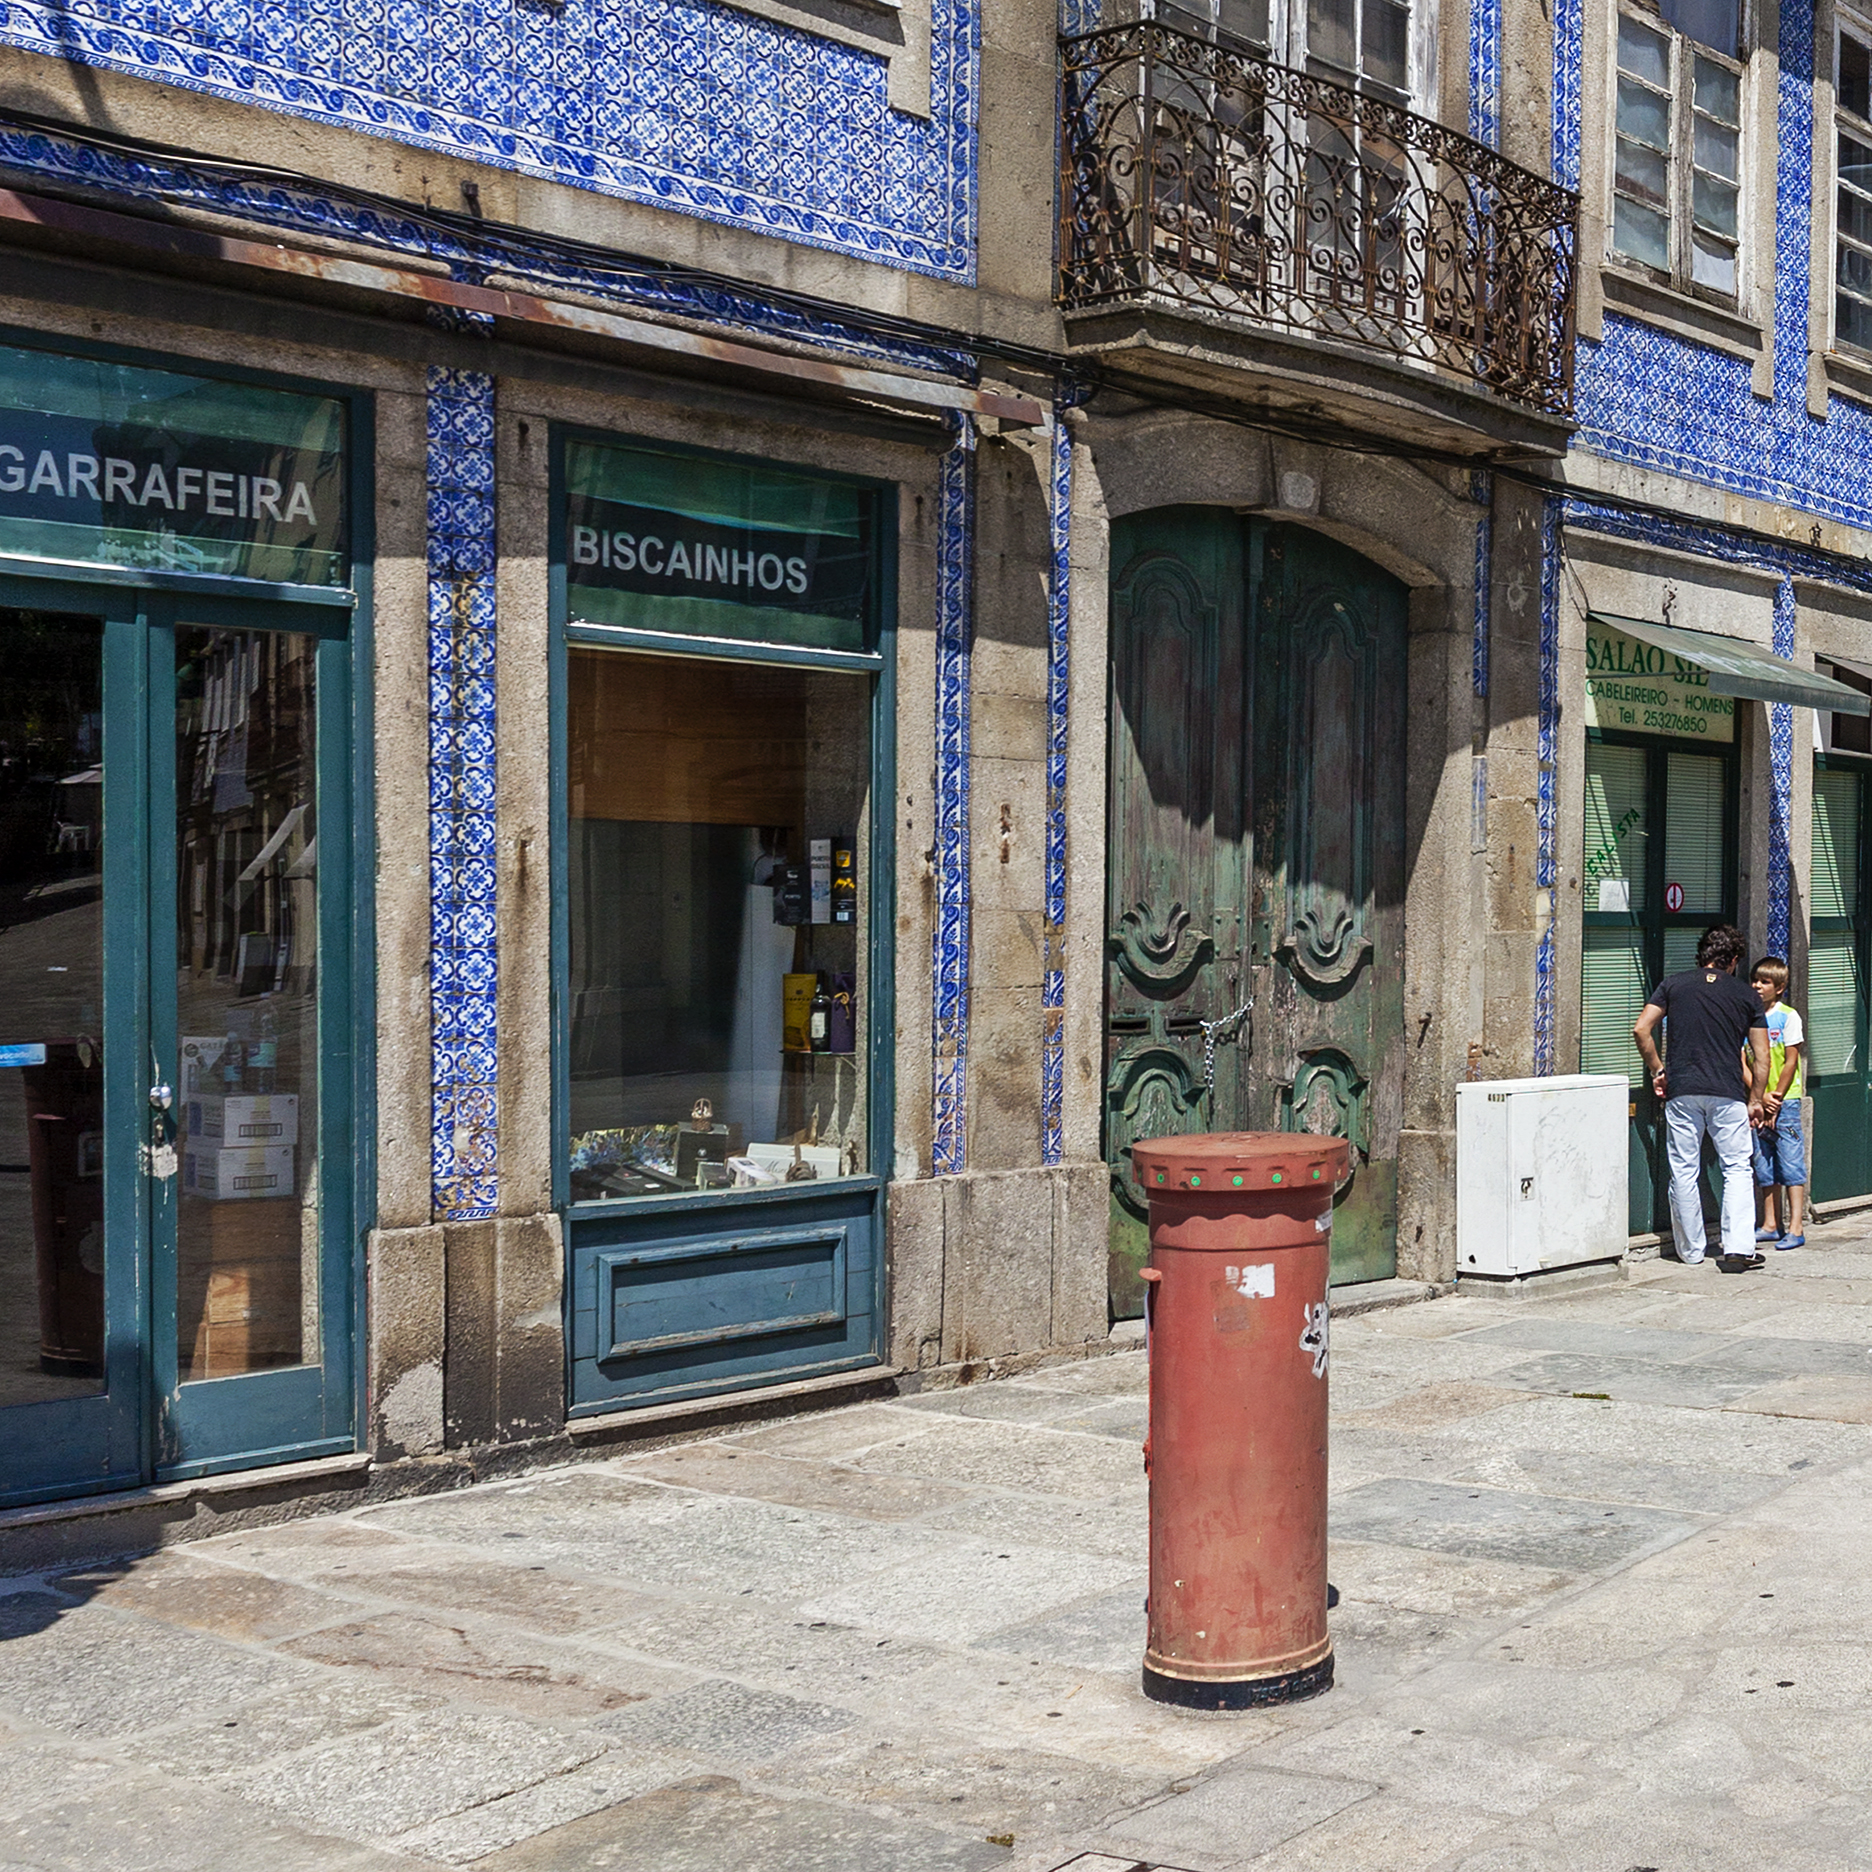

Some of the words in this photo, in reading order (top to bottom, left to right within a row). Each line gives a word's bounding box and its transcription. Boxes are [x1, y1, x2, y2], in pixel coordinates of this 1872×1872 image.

[0, 443, 318, 526] GARRAFEIRA
[573, 524, 808, 595] BISCAINHOS
[1585, 679, 1668, 707] CABELEIREIRO
[1684, 693, 1734, 716] HOMENS
[1618, 706, 1638, 725] Tel.
[1643, 709, 1707, 734] 253276850
